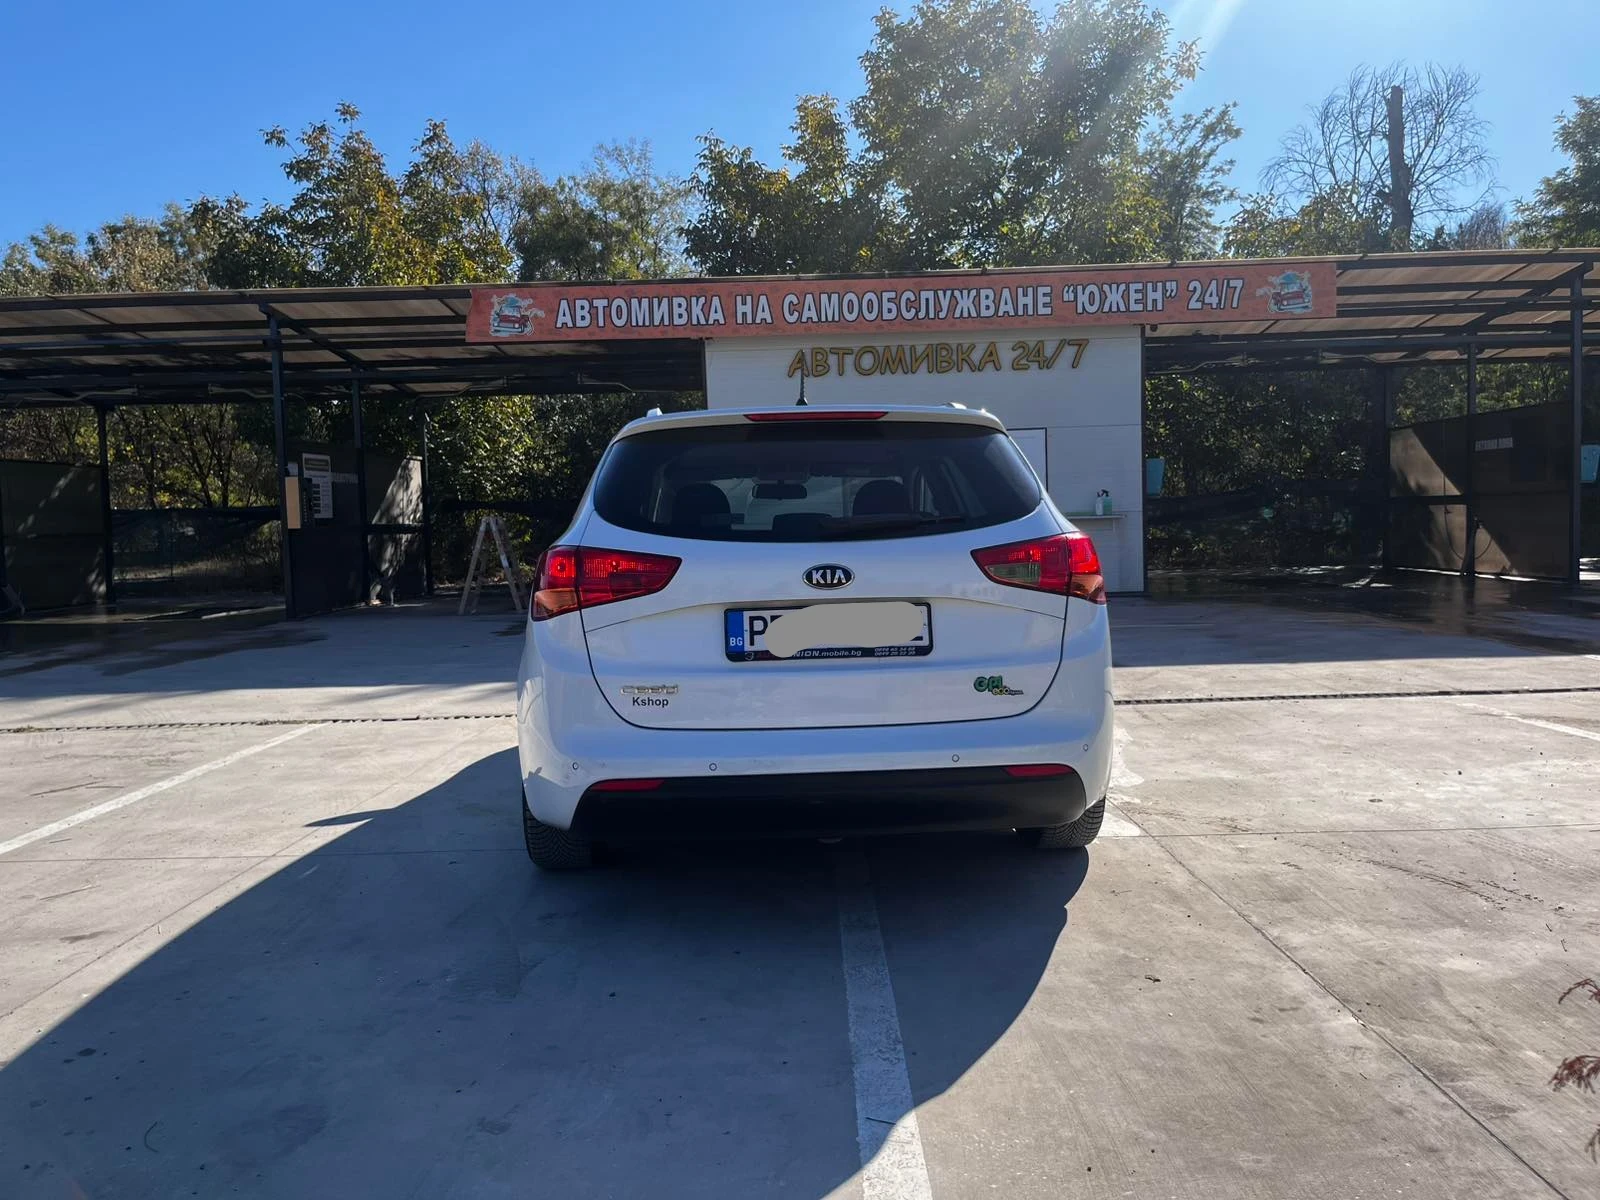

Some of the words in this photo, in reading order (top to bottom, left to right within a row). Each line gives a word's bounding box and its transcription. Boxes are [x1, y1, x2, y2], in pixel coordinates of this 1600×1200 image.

[555, 293, 725, 329] АВТОМИВКА
[735, 294, 773, 325] НА
[782, 284, 1053, 324] САМООБСЛУЖВАНЕ
[1187, 278, 1244, 311] 24/7
[787, 341, 1001, 378] АВТОМИВКА
[1011, 338, 1090, 372] 24/7
[811, 569, 847, 585] KIA
[729, 637, 743, 646] BG
[632, 696, 669, 708] Kshop
